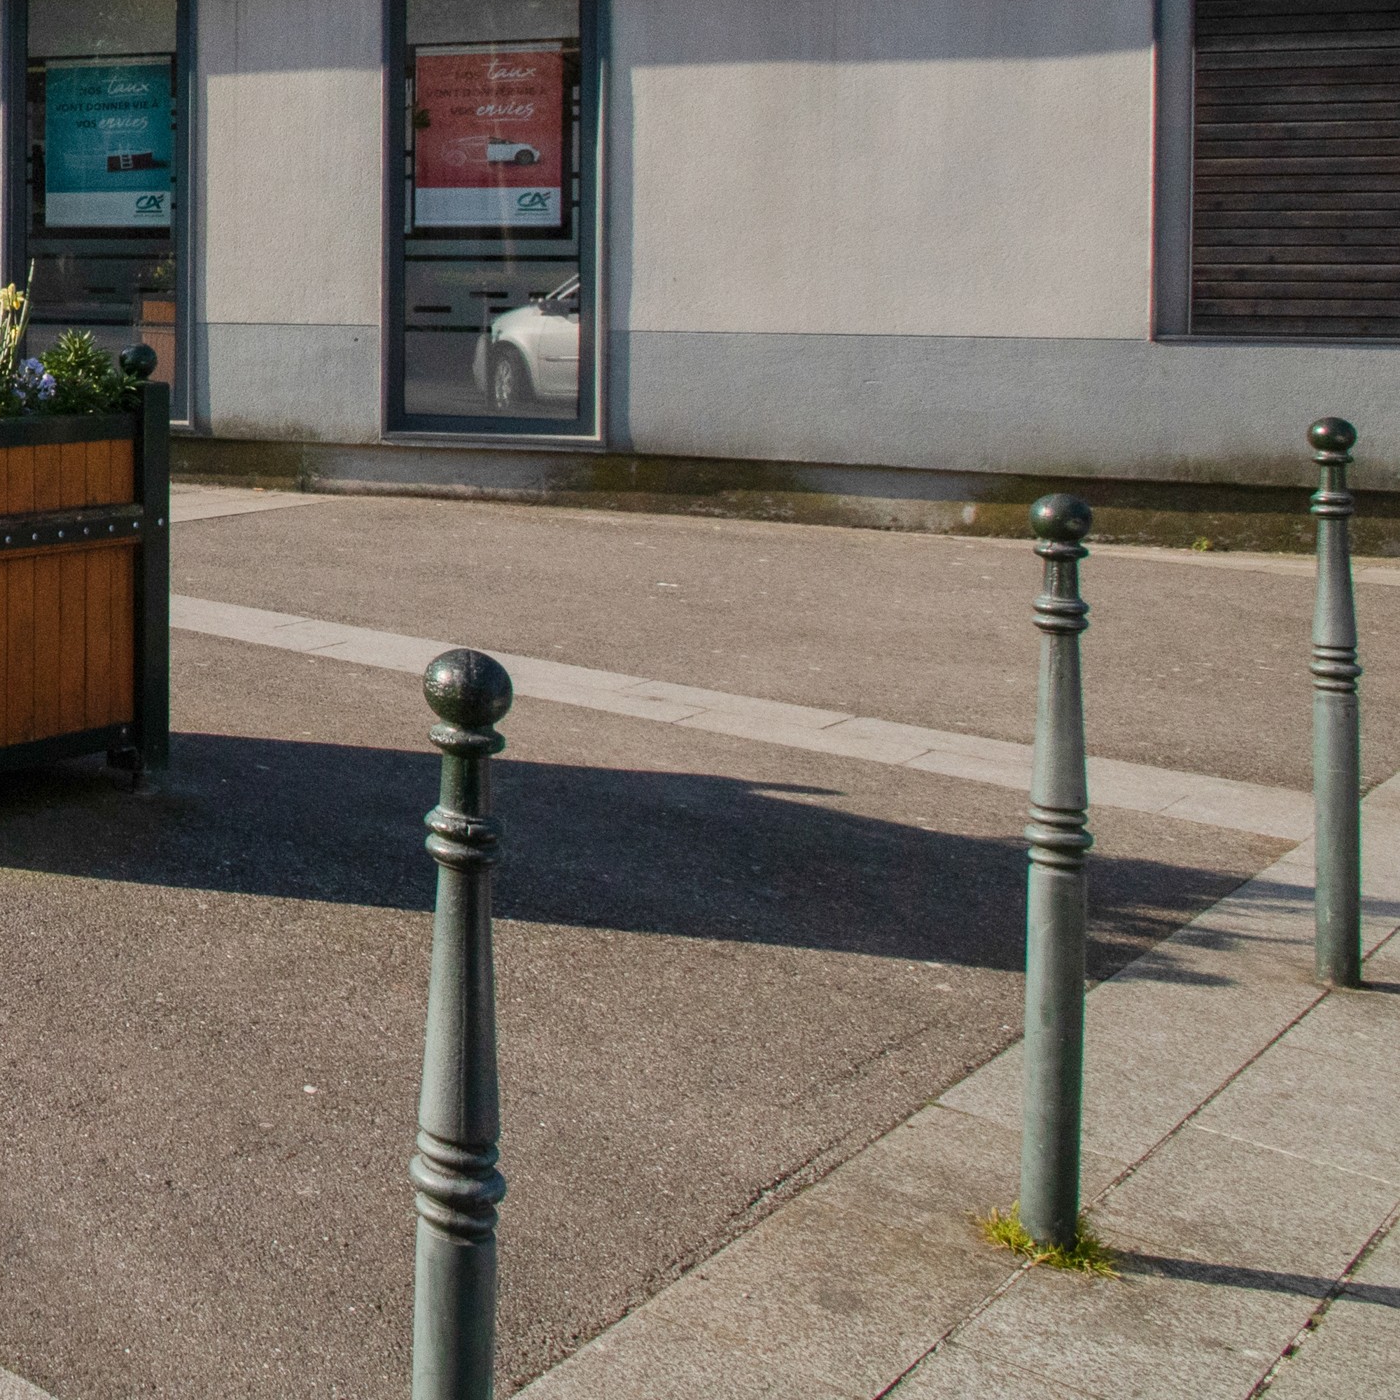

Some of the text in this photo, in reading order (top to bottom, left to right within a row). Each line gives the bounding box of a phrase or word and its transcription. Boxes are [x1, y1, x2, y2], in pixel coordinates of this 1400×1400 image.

[481, 58, 537, 80] taux
[102, 75, 149, 95] taux
[476, 101, 534, 117] envies
[99, 115, 149, 130] envies
